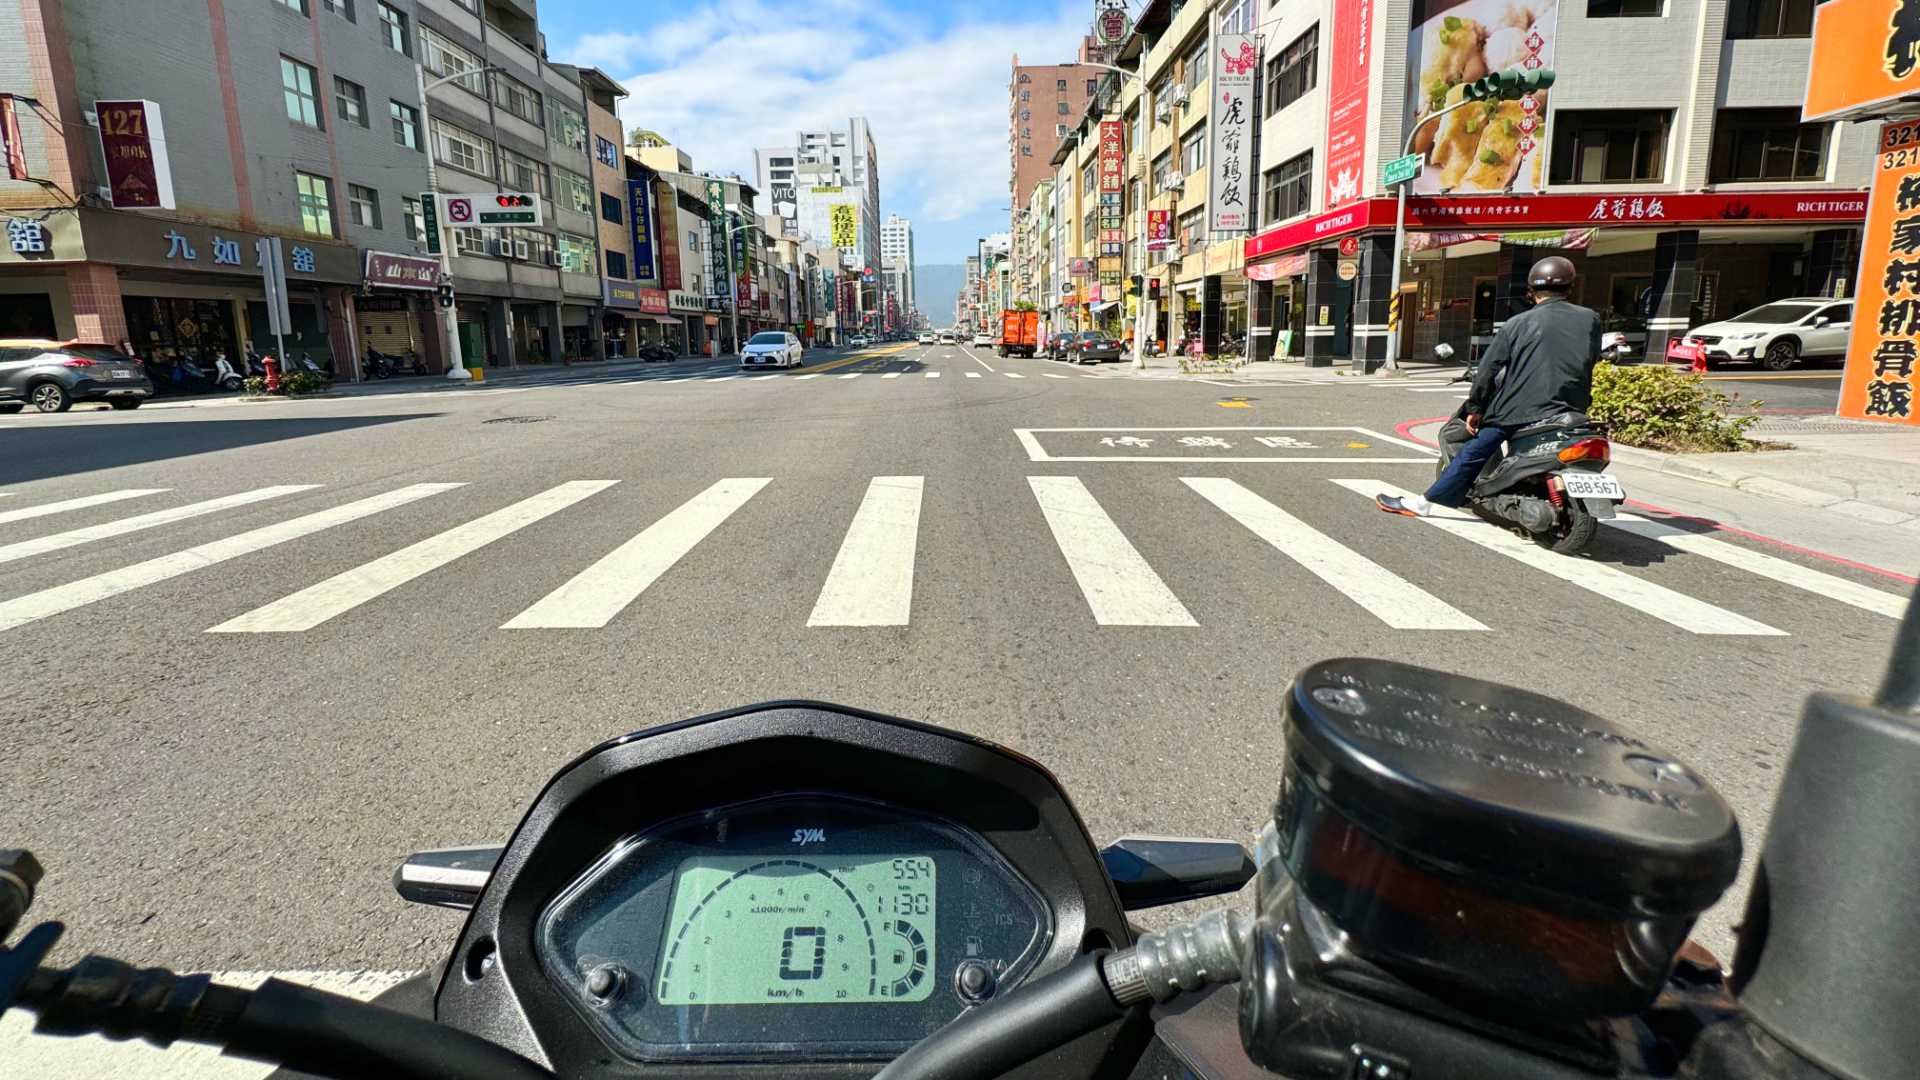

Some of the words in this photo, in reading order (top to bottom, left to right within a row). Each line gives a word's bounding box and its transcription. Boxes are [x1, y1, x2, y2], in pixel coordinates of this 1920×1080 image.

[102, 109, 142, 135] 127
[1797, 201, 1826, 212] RICH
[1828, 201, 1864, 212] TIGER
[792, 829, 826, 846] SYM
[878, 894, 929, 915] 1130
[725, 910, 731, 918] 3
[825, 910, 831, 918] 7
[883, 922, 891, 931] F
[704, 936, 712, 945] 2
[837, 934, 844, 943] 8
[779, 926, 826, 980] 0
[694, 964, 700, 973] 1
[842, 963, 848, 971] 9
[767, 987, 804, 998] km/h
[835, 989, 847, 998] 10
[881, 985, 888, 996] E
[689, 992, 695, 1000] 0
